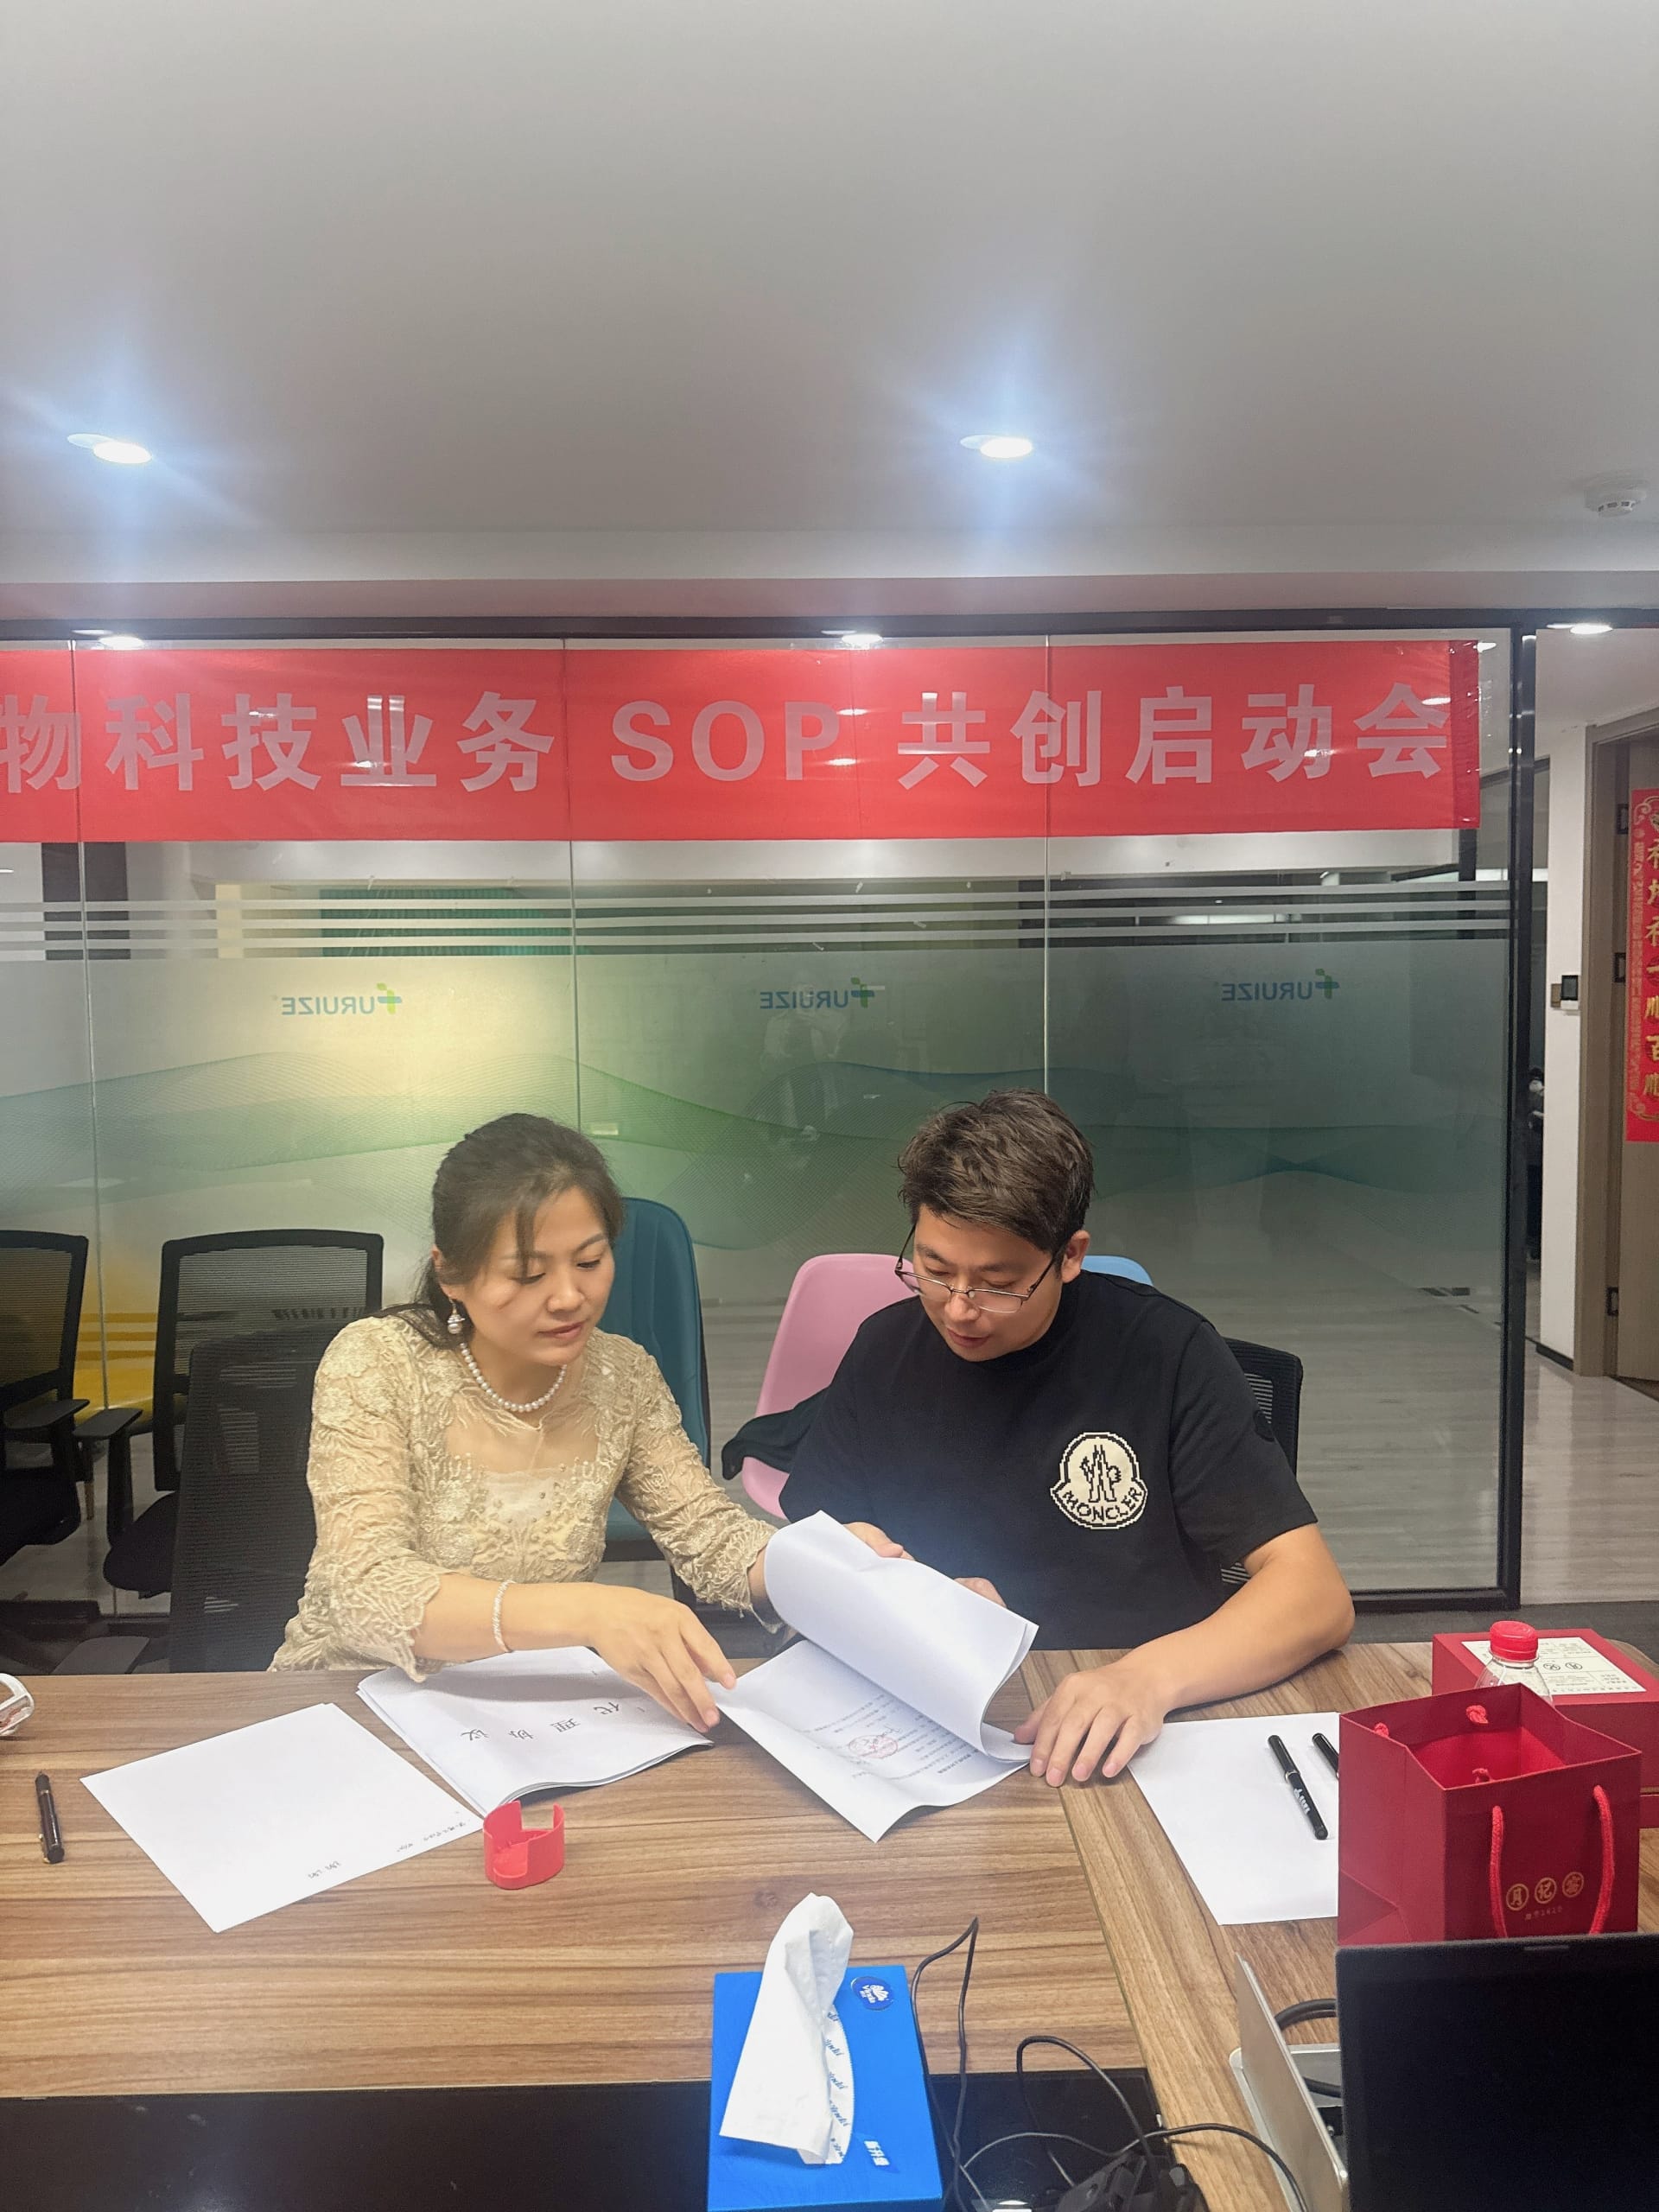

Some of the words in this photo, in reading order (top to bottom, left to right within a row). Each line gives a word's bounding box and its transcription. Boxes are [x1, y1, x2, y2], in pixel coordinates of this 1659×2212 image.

[0, 691, 554, 792] 物科技业务
[611, 699, 841, 784] SOP
[898, 682, 1451, 791] 共创启动会
